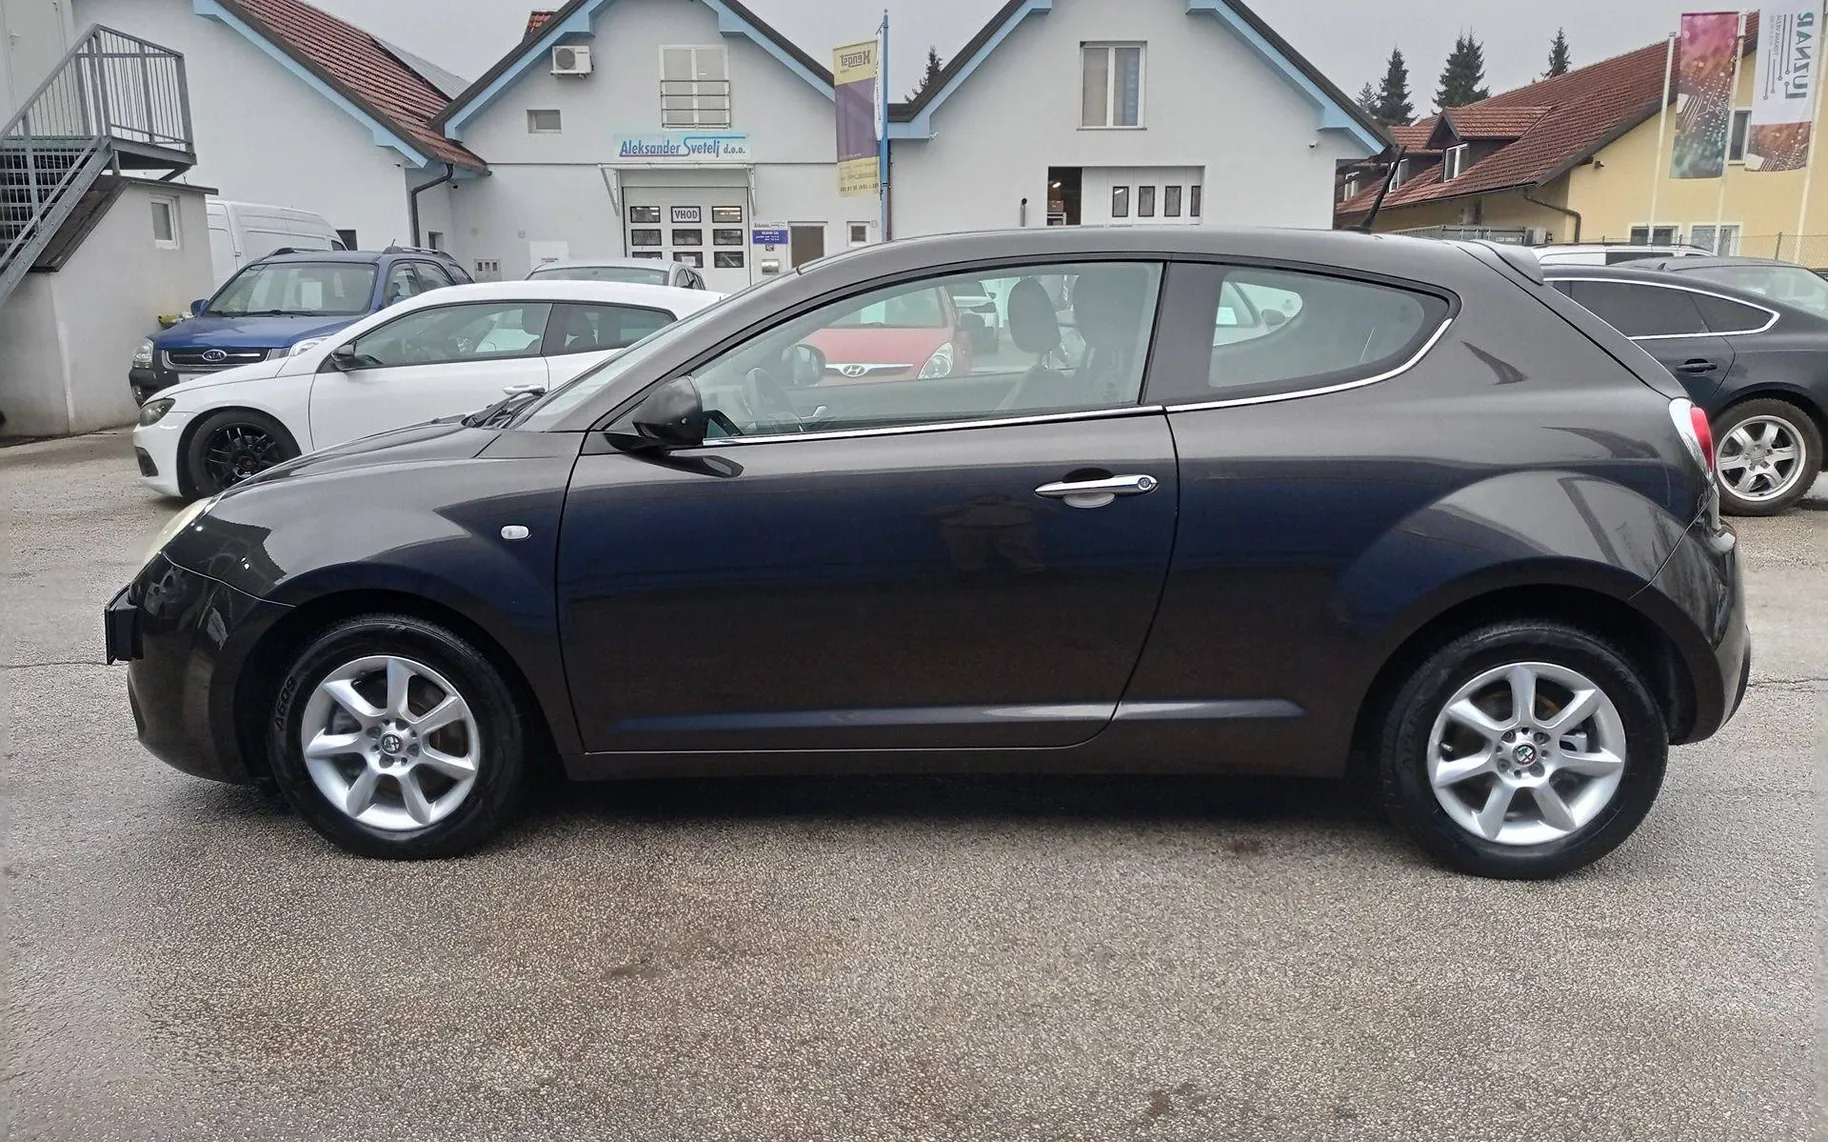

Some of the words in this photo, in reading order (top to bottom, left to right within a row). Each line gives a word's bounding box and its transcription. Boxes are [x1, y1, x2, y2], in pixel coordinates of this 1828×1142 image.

[619, 140, 681, 156] Aleksander
[683, 136, 720, 157] Svetelj
[723, 144, 746, 154] d.o.o.
[674, 210, 698, 219] VHOD
